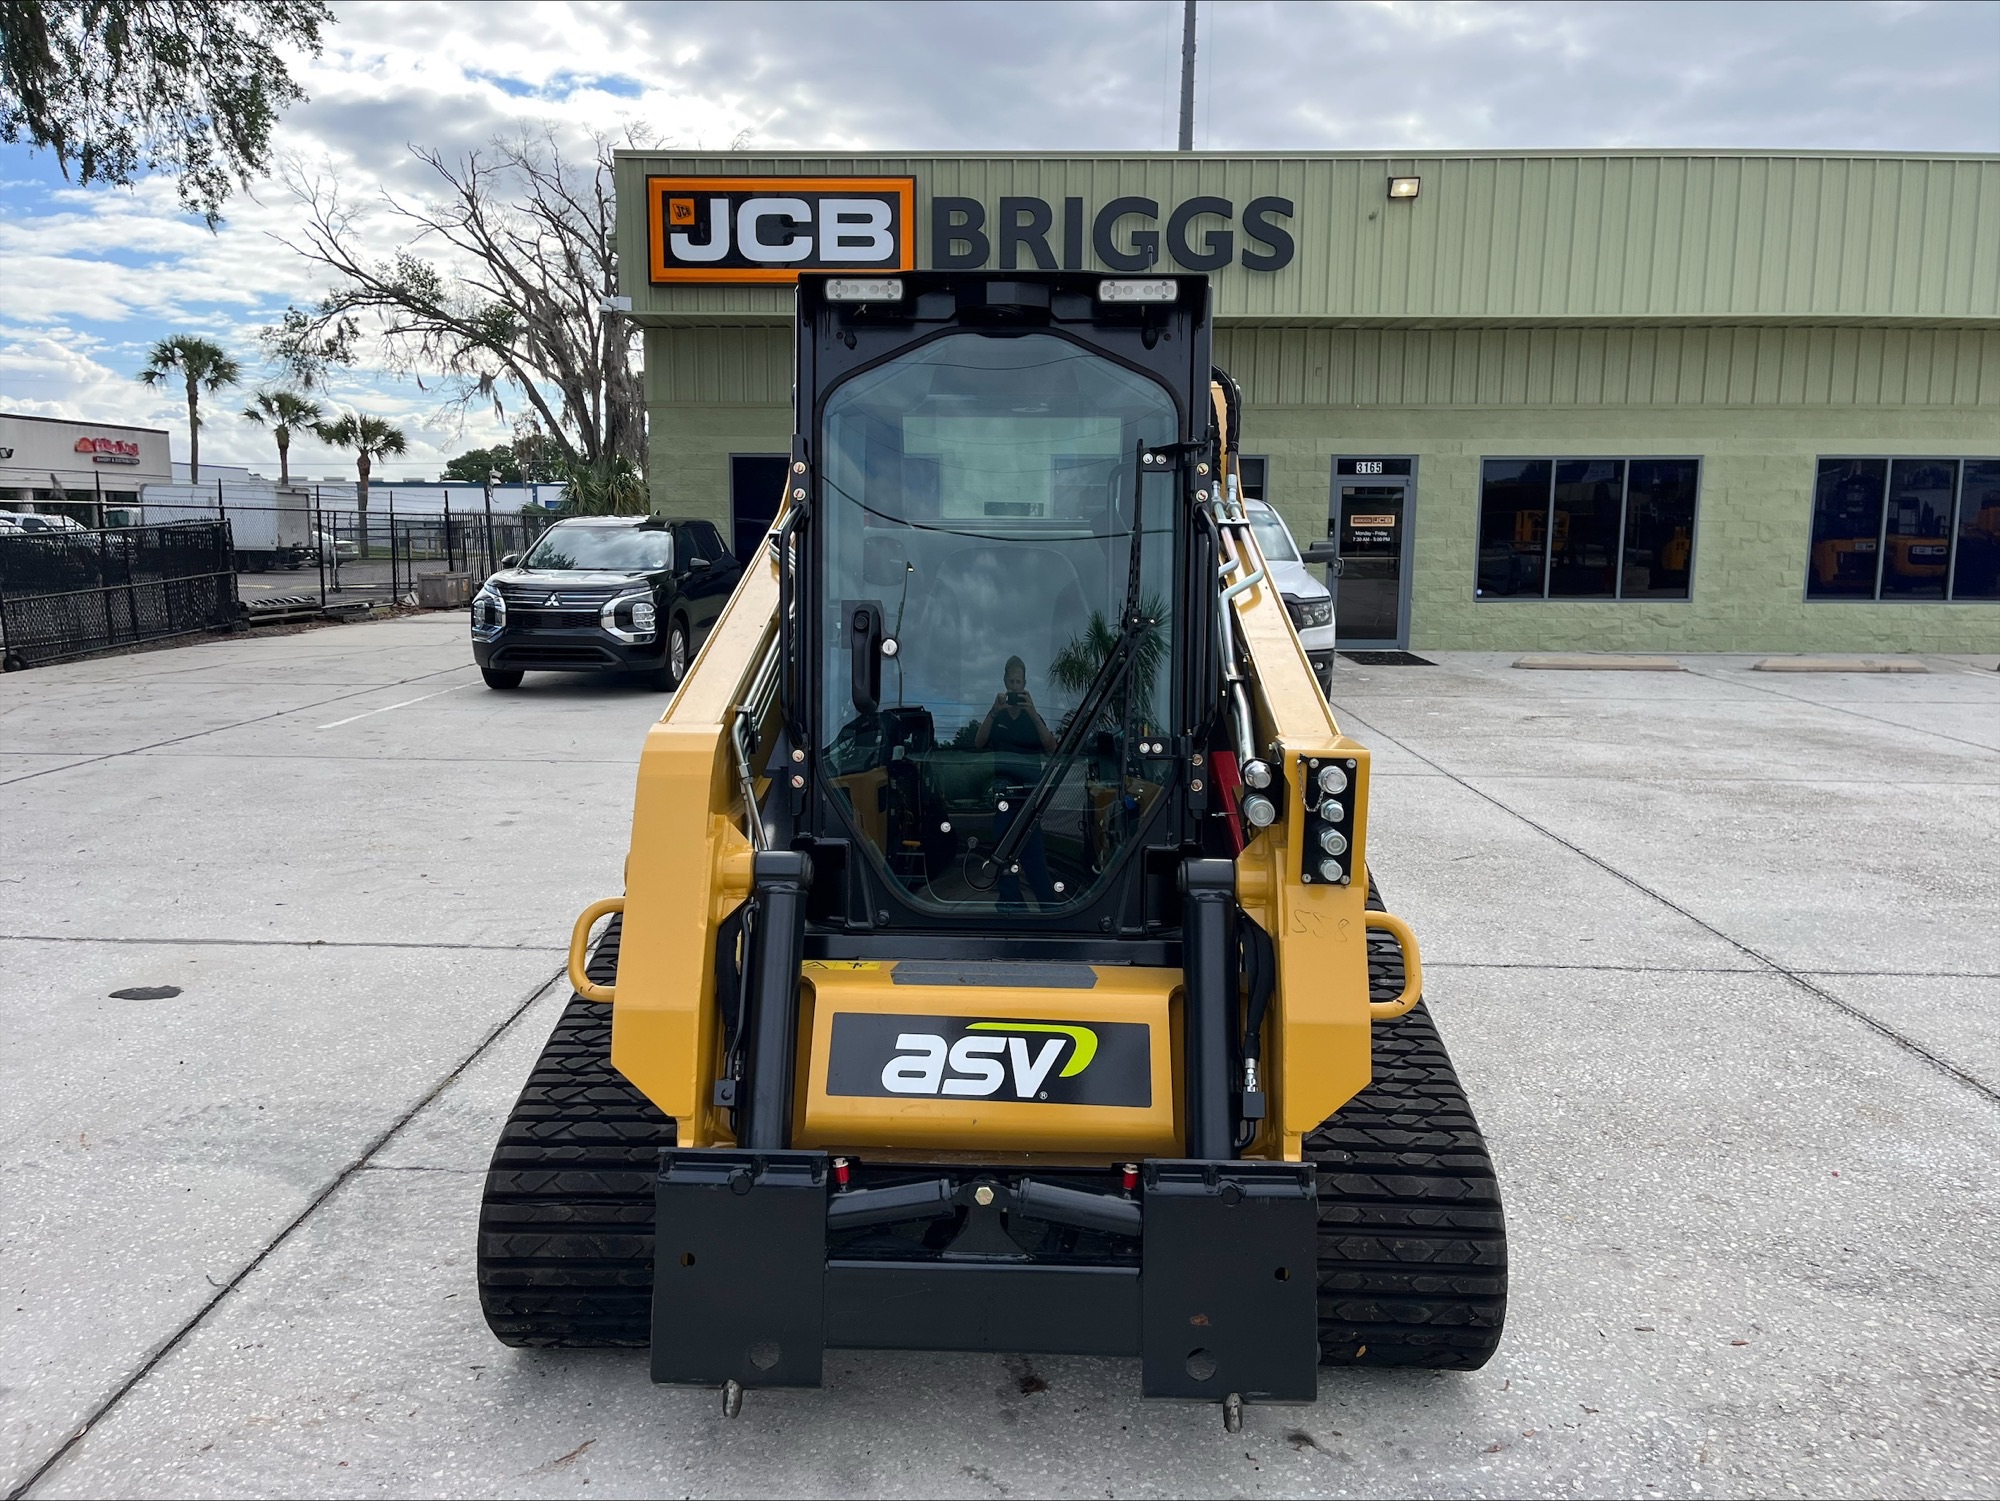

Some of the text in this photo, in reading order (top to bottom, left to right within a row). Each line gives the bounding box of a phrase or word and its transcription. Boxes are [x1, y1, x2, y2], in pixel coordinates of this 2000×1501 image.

[670, 196, 1295, 272] JCB BRIGGS
[1357, 462, 1381, 473] 3165
